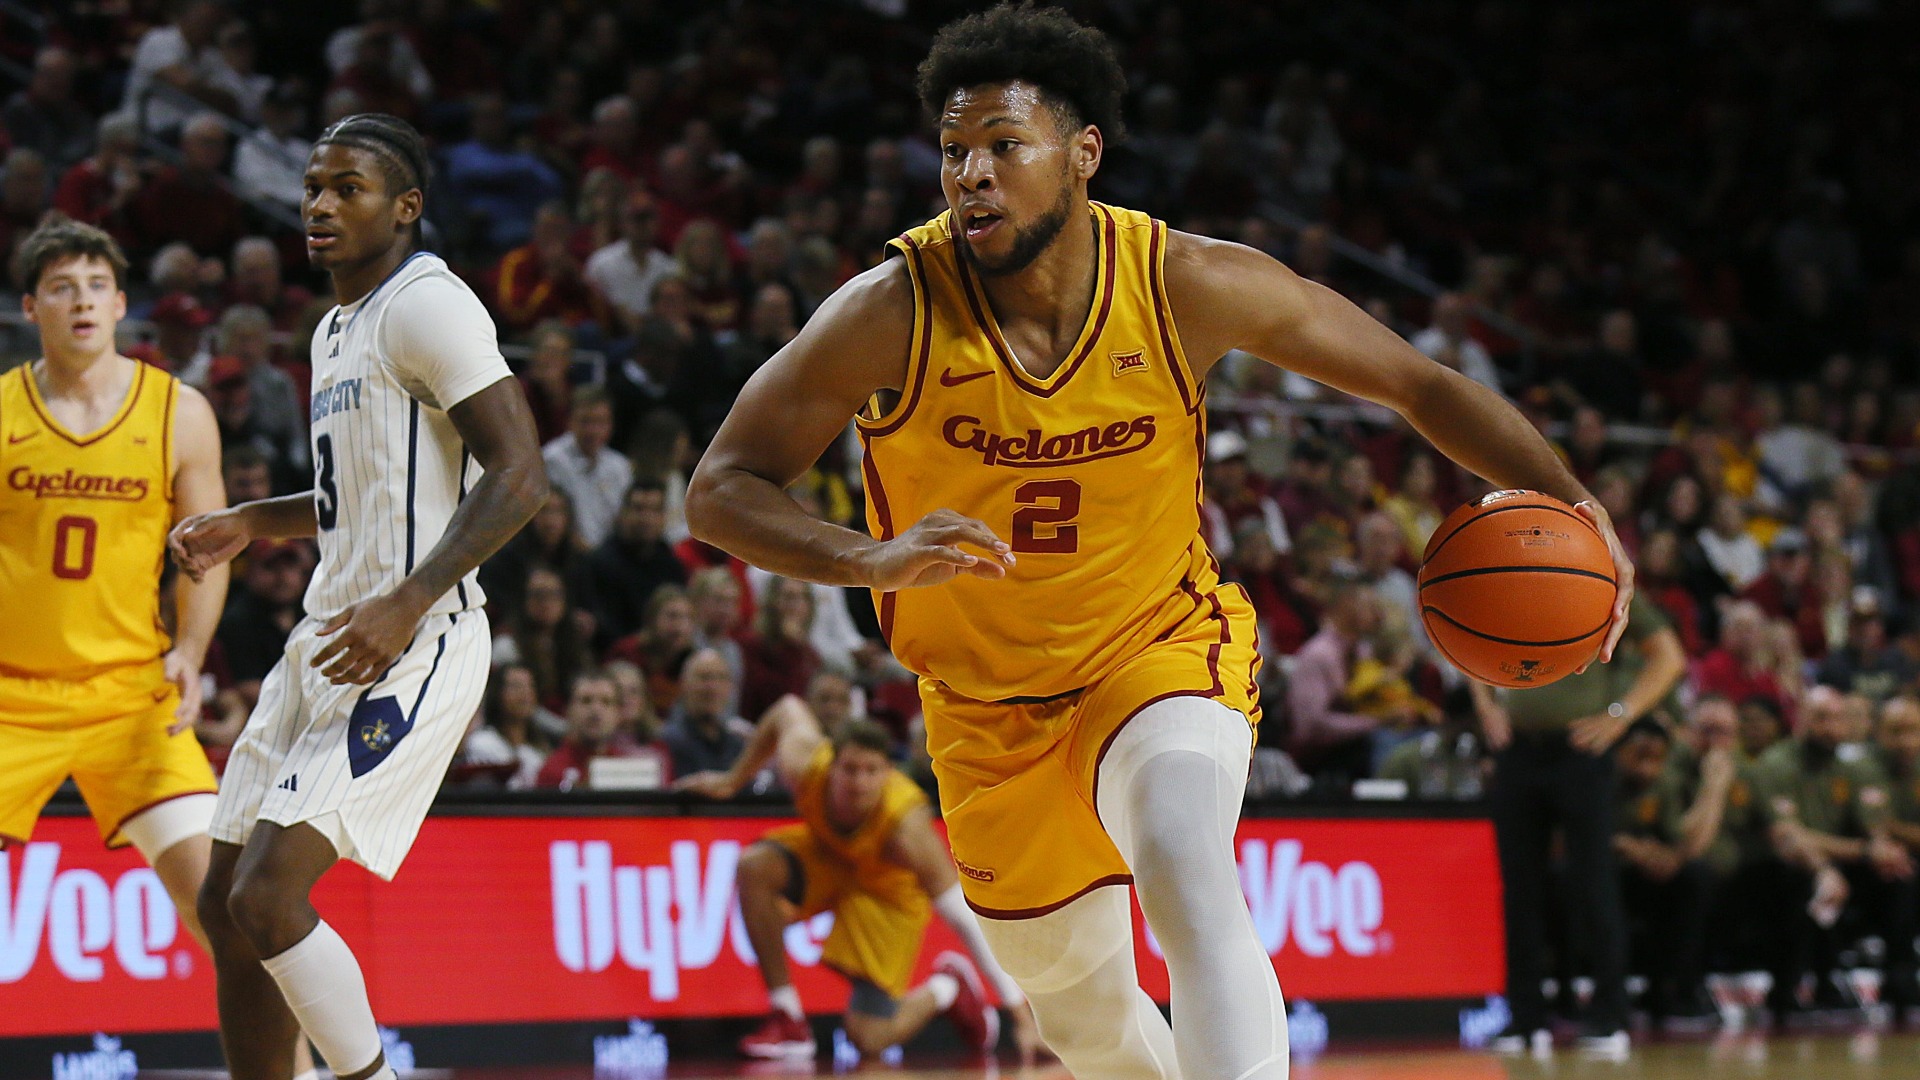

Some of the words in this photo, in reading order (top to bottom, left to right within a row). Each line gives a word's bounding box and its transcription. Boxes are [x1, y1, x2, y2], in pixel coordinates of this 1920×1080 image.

[332, 377, 362, 413] CITY
[942, 414, 1157, 468] Cyclones
[7, 465, 148, 502] Cyclones
[317, 432, 338, 532] 3
[52, 515, 98, 580] 0
[1011, 477, 1082, 554] 2
[550, 839, 836, 1002] HyV
